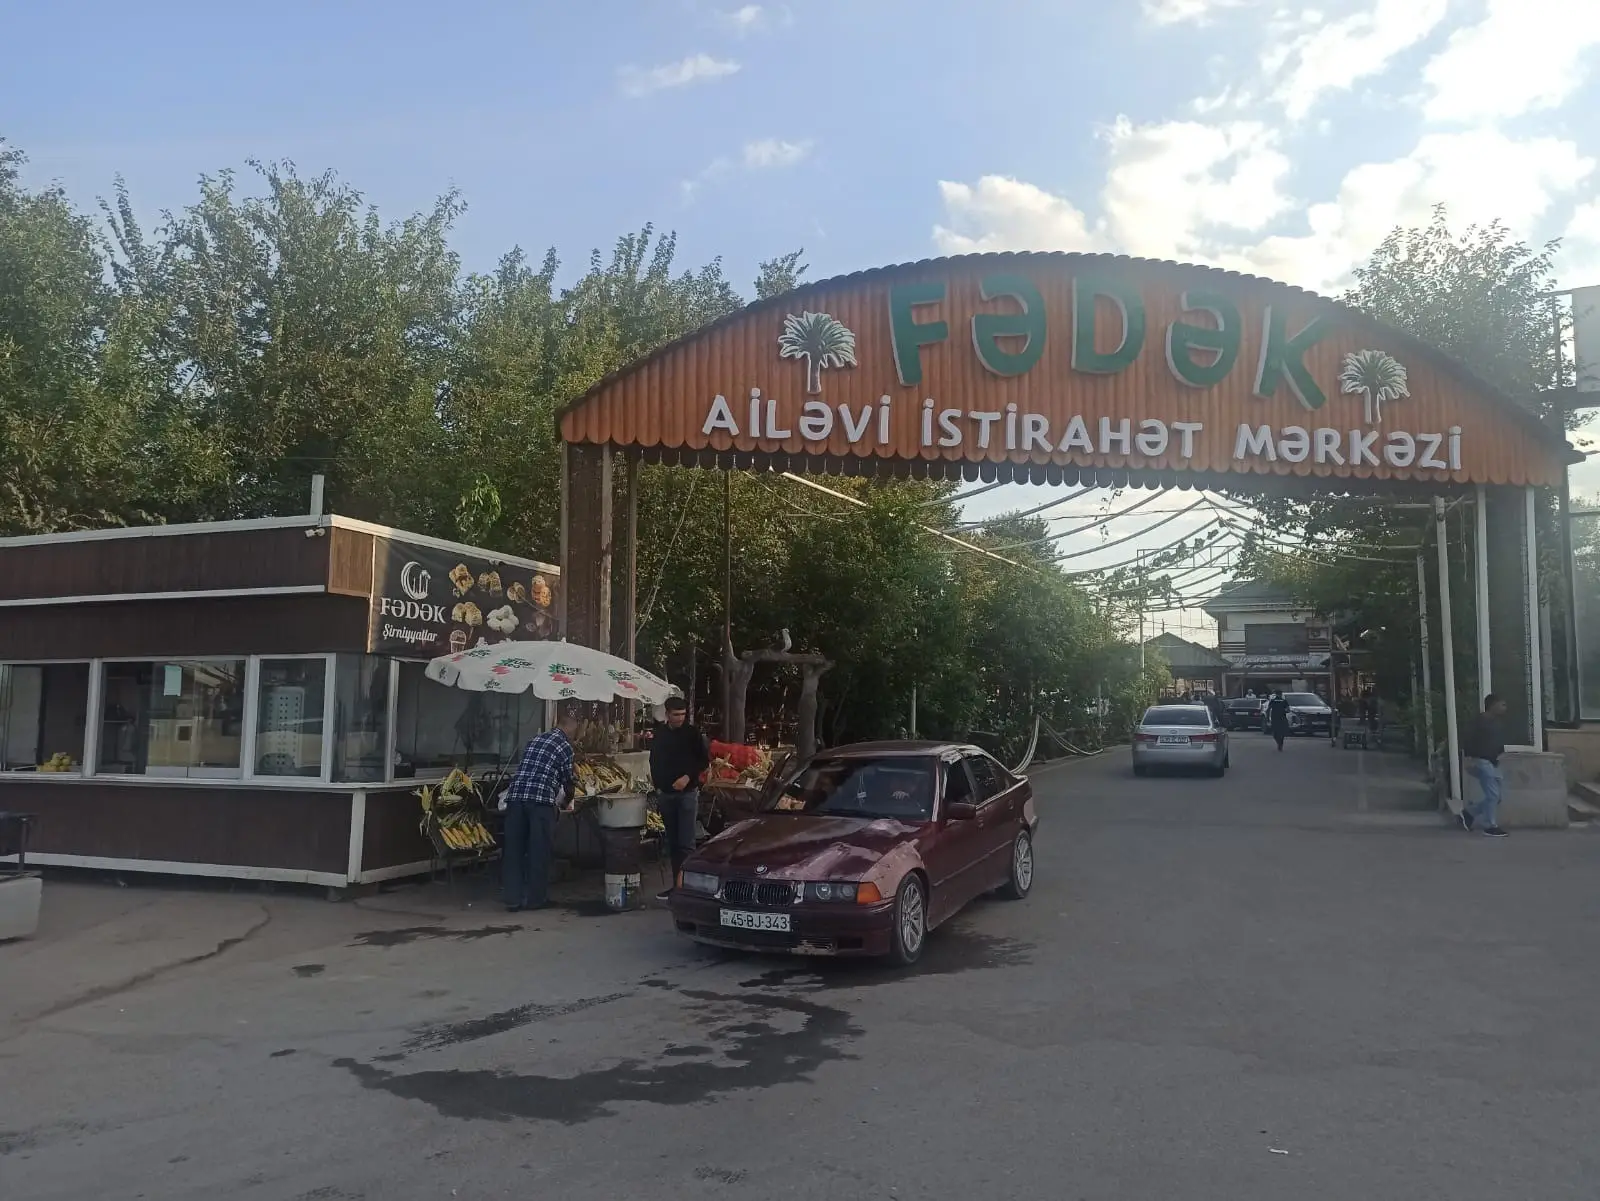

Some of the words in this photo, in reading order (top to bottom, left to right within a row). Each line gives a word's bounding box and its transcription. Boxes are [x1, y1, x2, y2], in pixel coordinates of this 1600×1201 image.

[889, 273, 1327, 411] FƏDƏK
[702, 387, 891, 444] AİLƏVİ
[921, 398, 1203, 458] İSTİRAHƏT
[1233, 422, 1462, 471] MƏRKƏZİ
[380, 597, 447, 624] FƏDƏK
[382, 623, 438, 644] Şirniyyatlar
